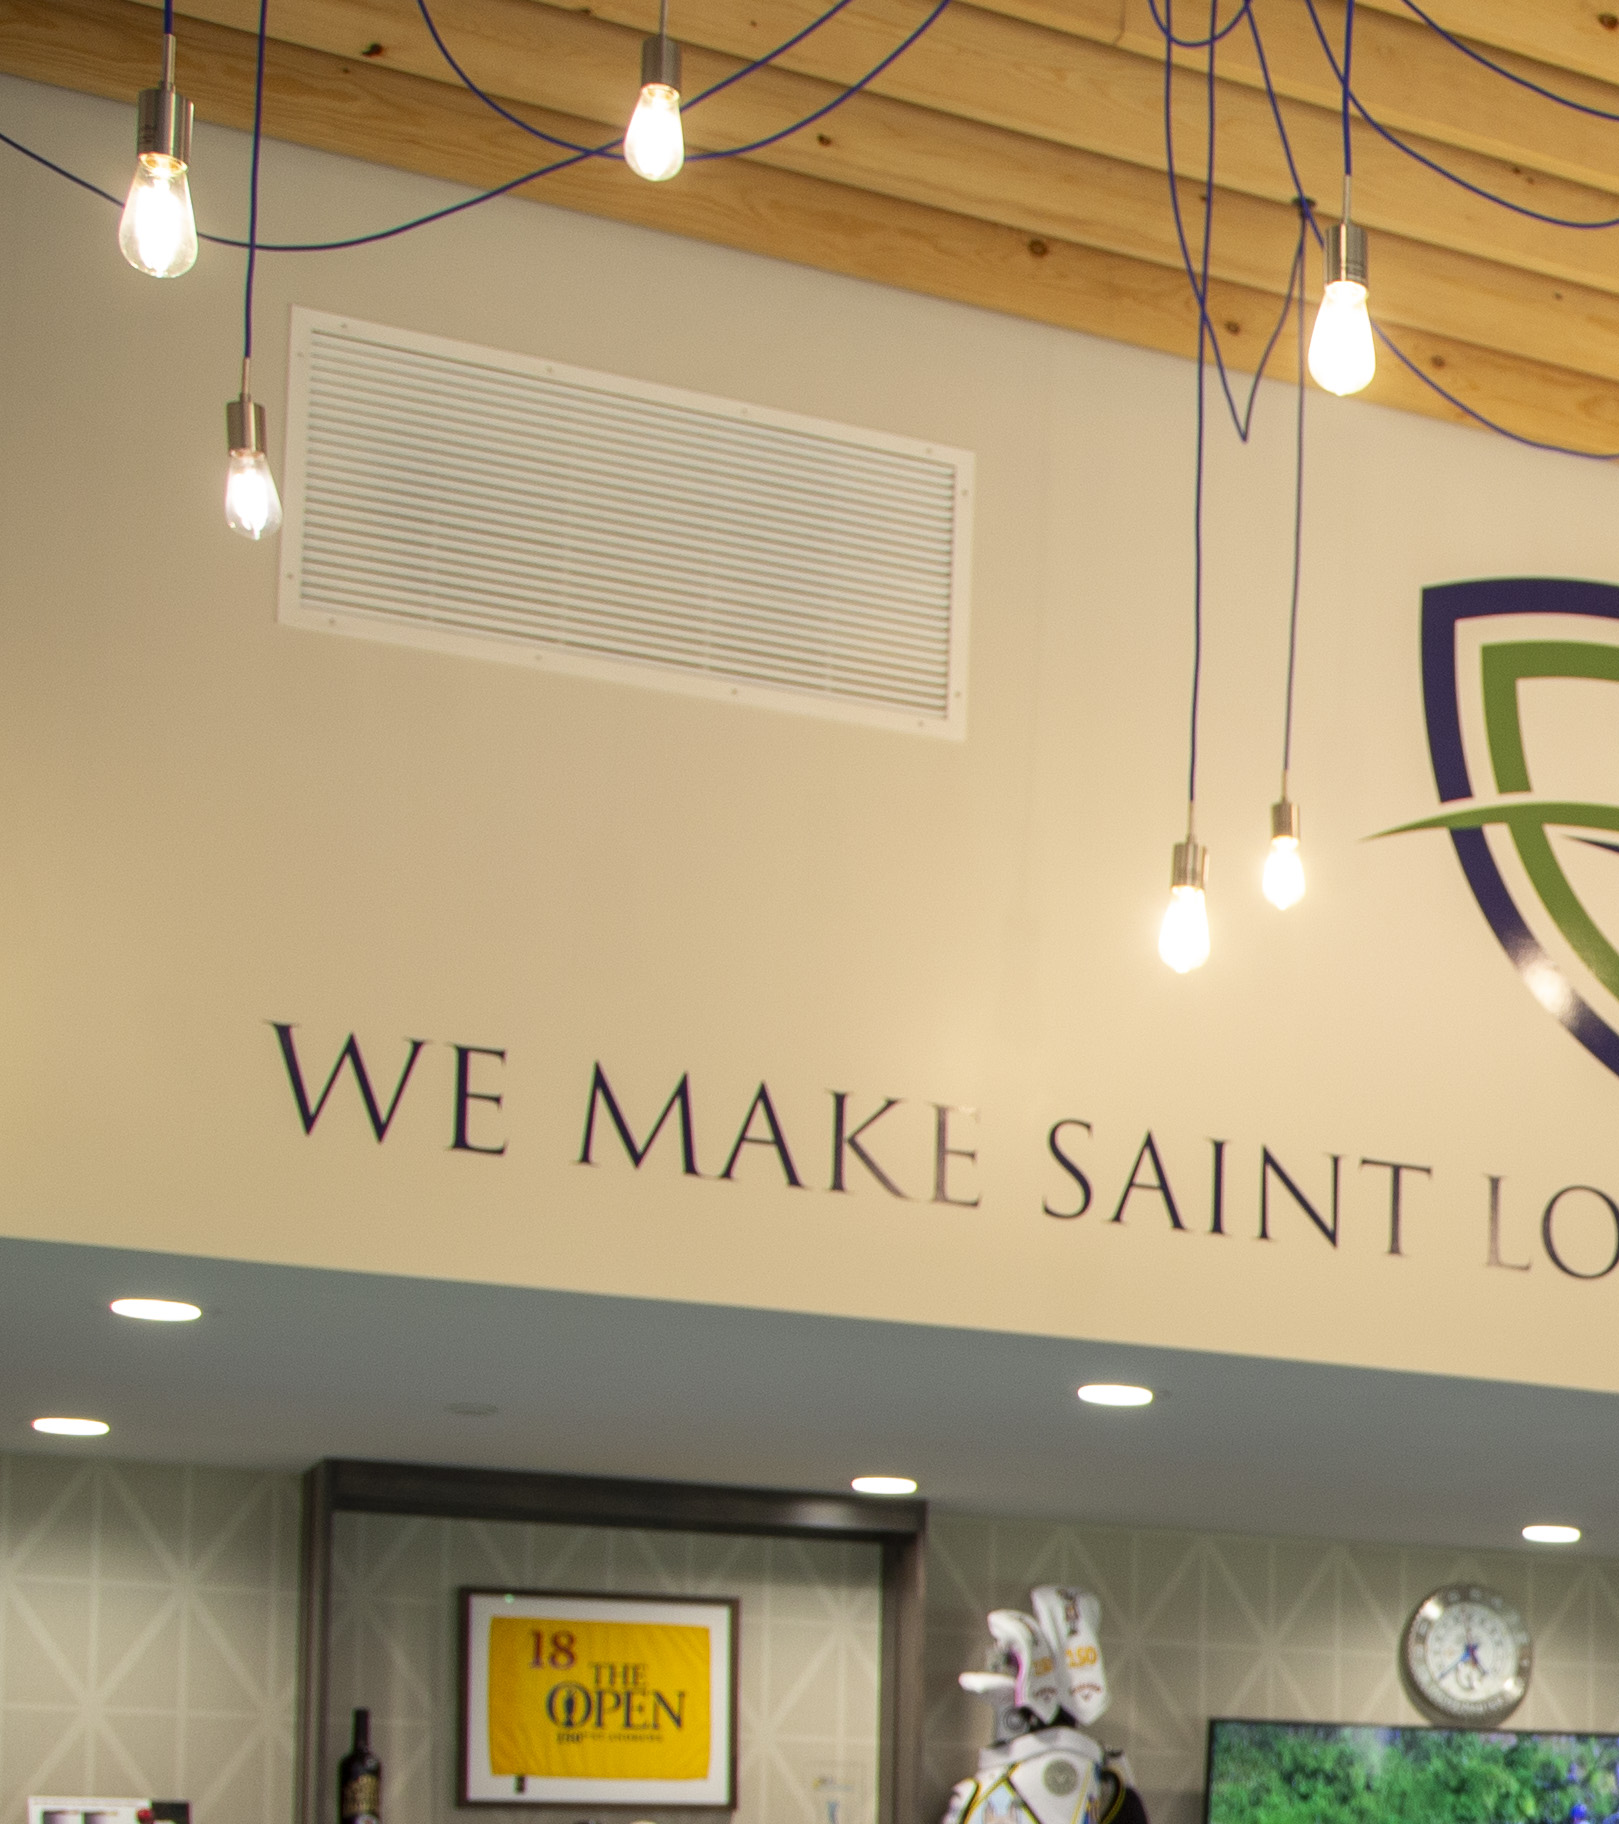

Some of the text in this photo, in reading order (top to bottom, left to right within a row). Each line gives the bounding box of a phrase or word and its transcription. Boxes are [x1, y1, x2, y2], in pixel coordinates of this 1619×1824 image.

[262, 1020, 508, 1157] WE
[572, 1057, 983, 1210] MAKE
[1042, 1116, 1434, 1258] SAINT
[529, 1628, 578, 1671] 18
[588, 1662, 649, 1688] THE
[545, 1681, 688, 1731] OPEN
